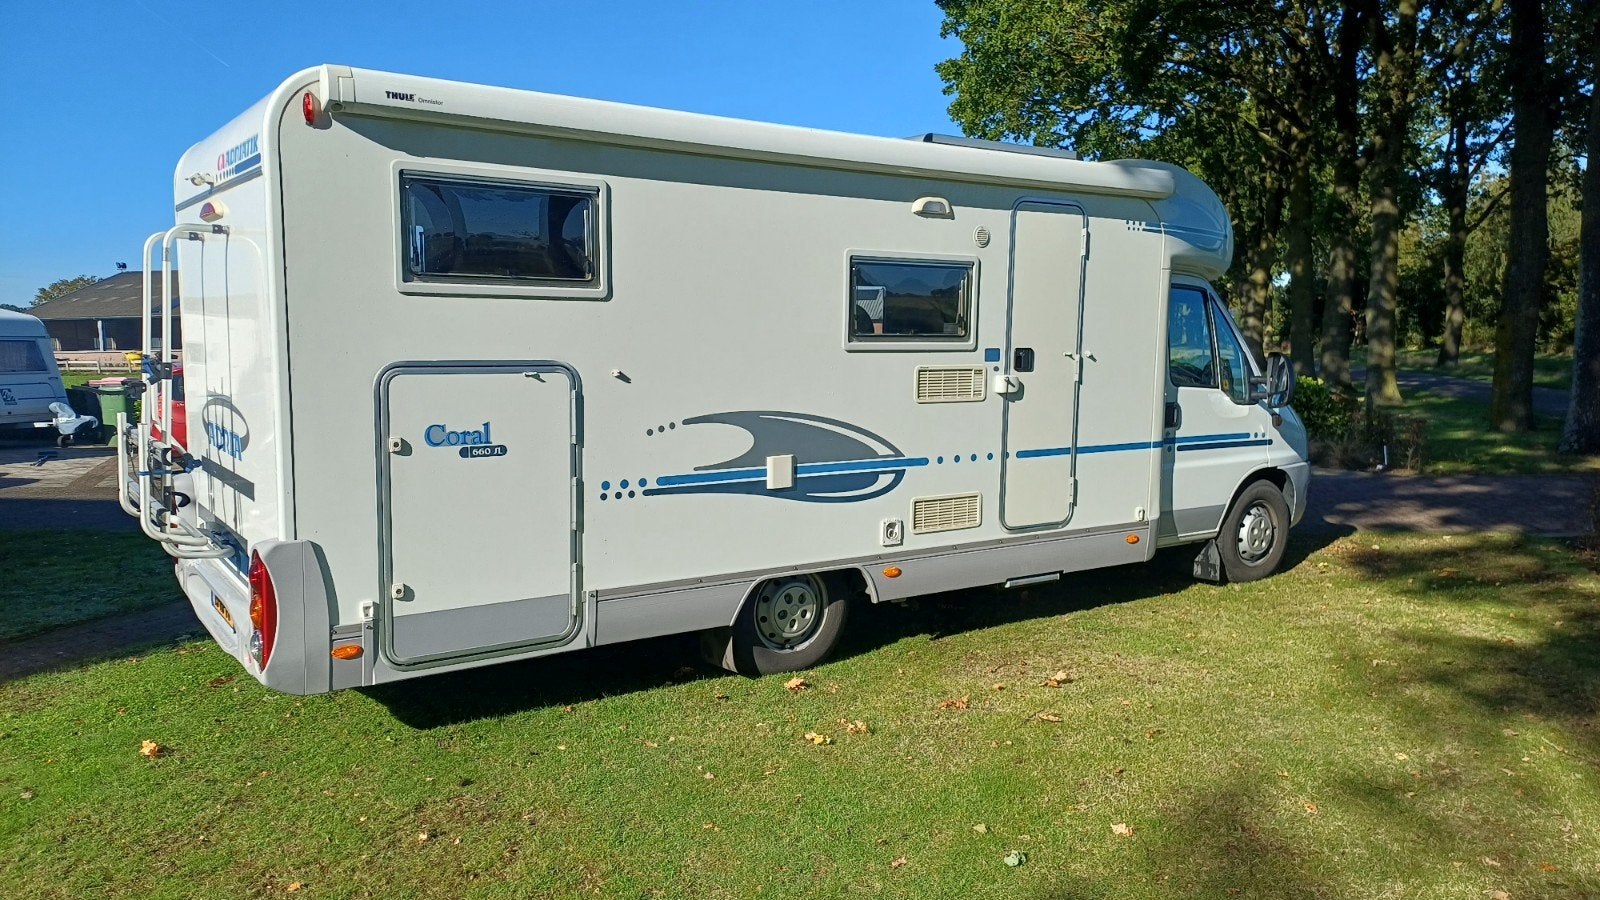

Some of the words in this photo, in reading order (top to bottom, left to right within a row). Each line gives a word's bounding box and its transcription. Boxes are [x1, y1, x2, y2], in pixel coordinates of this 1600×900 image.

[385, 90, 415, 102] THULE
[208, 421, 243, 462] ADRIA
[424, 421, 493, 447] Coral
[472, 447, 491, 456] 660
